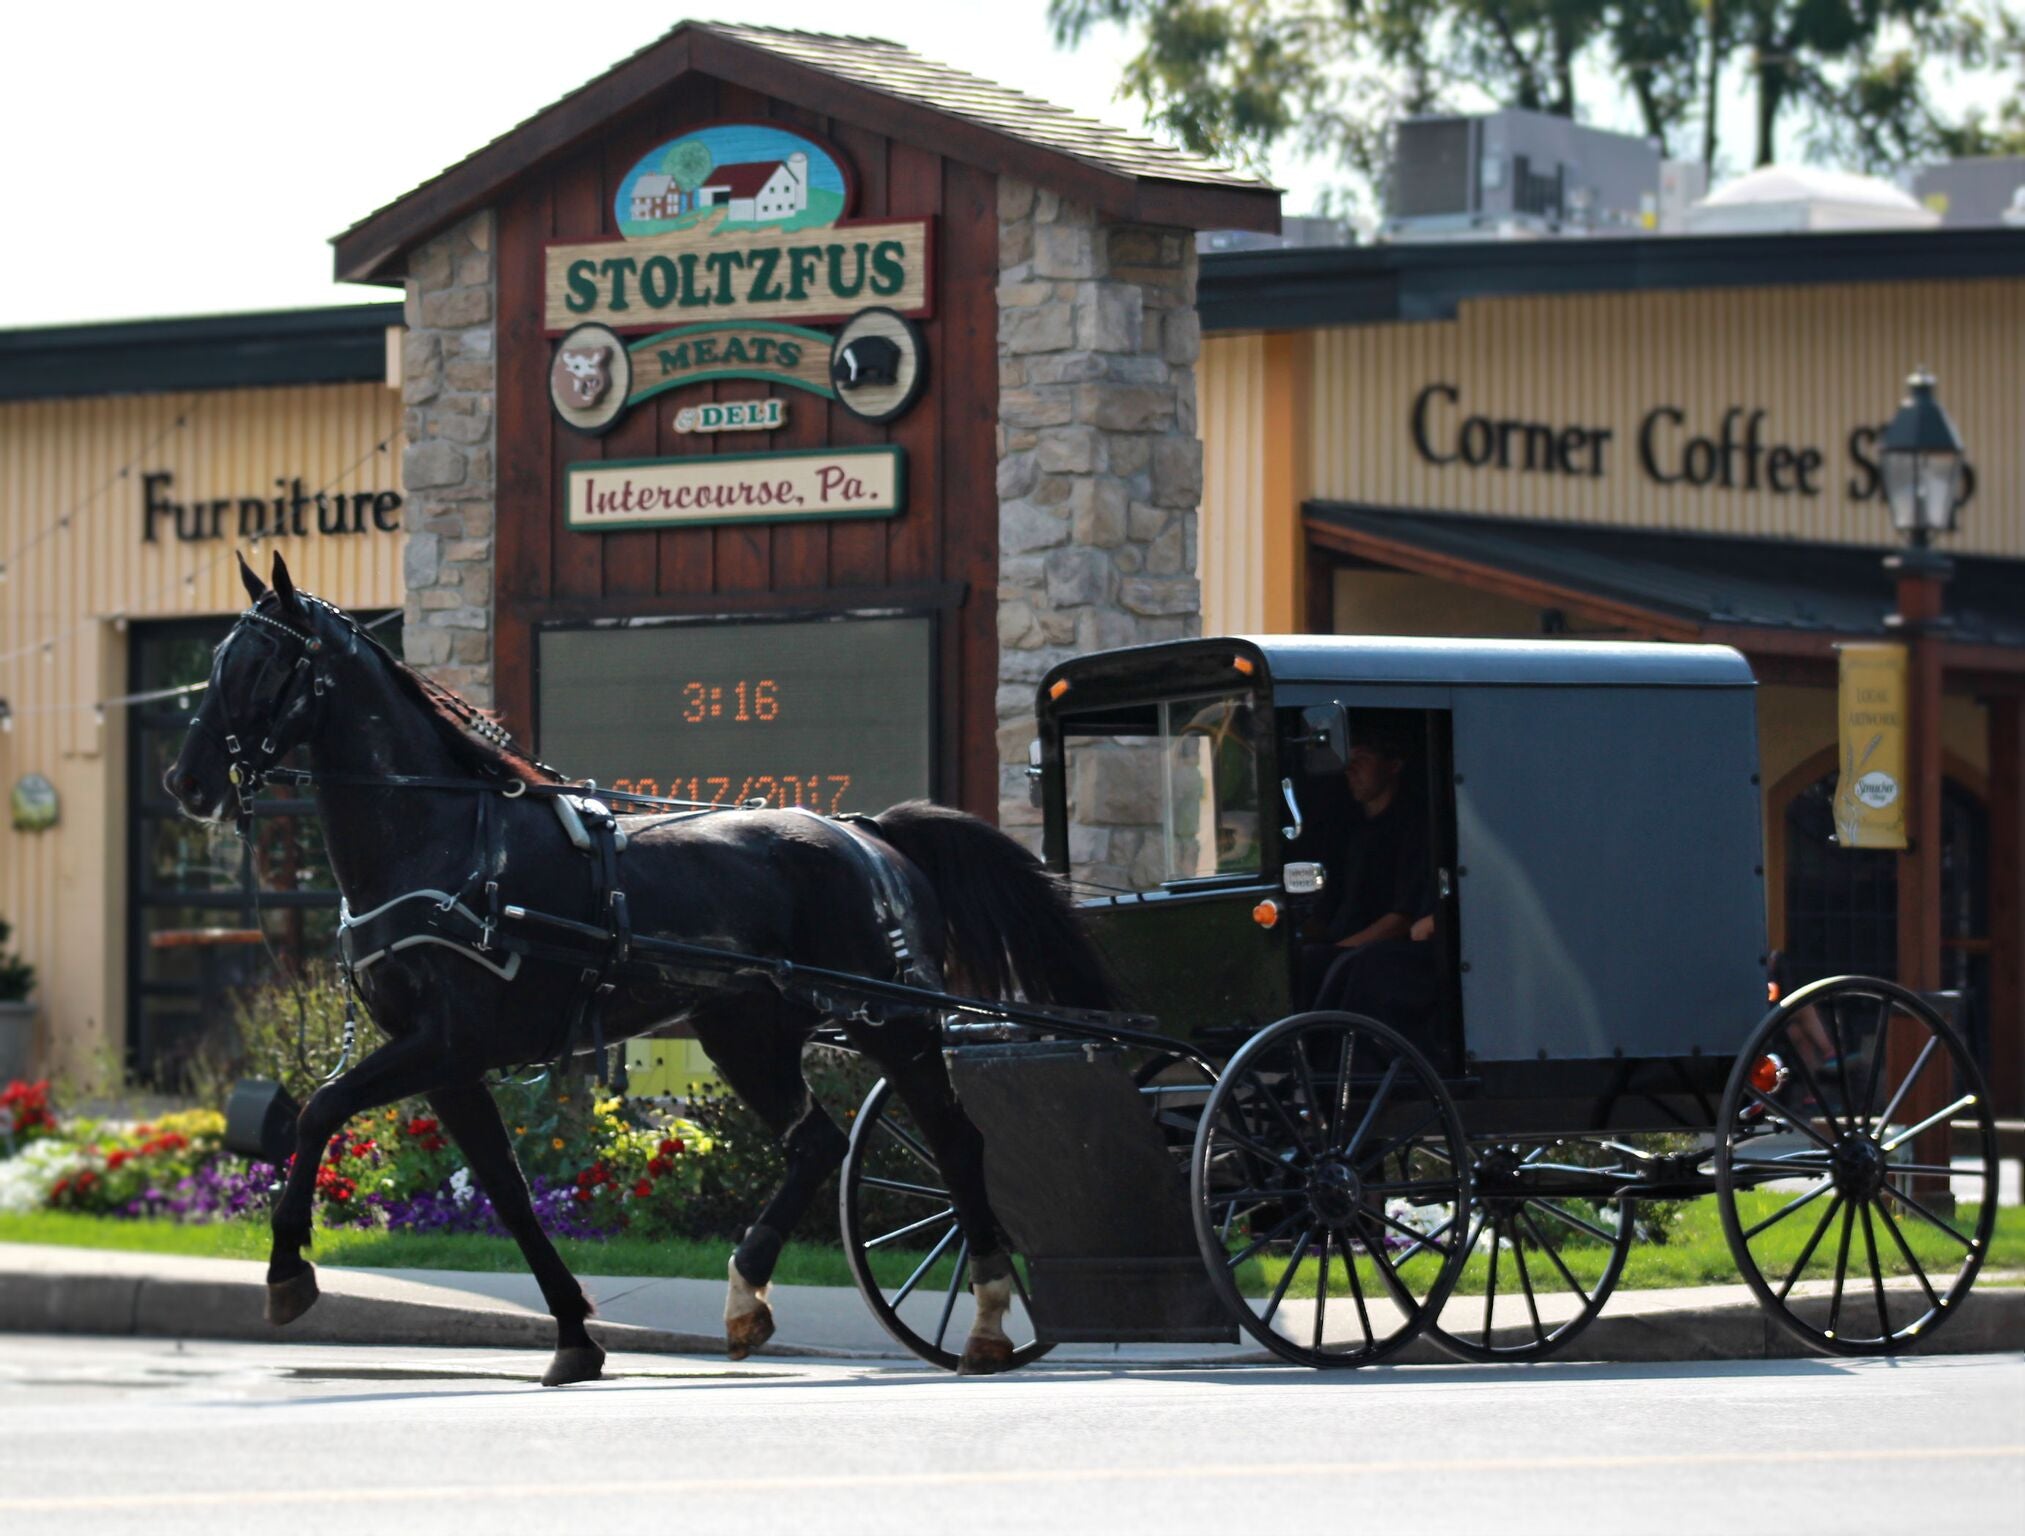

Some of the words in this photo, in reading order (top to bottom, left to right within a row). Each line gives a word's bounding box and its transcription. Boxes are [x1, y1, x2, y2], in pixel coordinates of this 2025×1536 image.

[565, 240, 905, 312] STOLTZFUS
[658, 336, 803, 375] MEATS
[701, 402, 779, 427] DELI
[1411, 382, 1613, 478] Corner
[1638, 406, 1823, 496] Coffee
[141, 470, 403, 543] Furniture
[584, 478, 806, 515] Intercourse,
[815, 465, 879, 503] Pa.
[683, 679, 779, 722] 3:16
